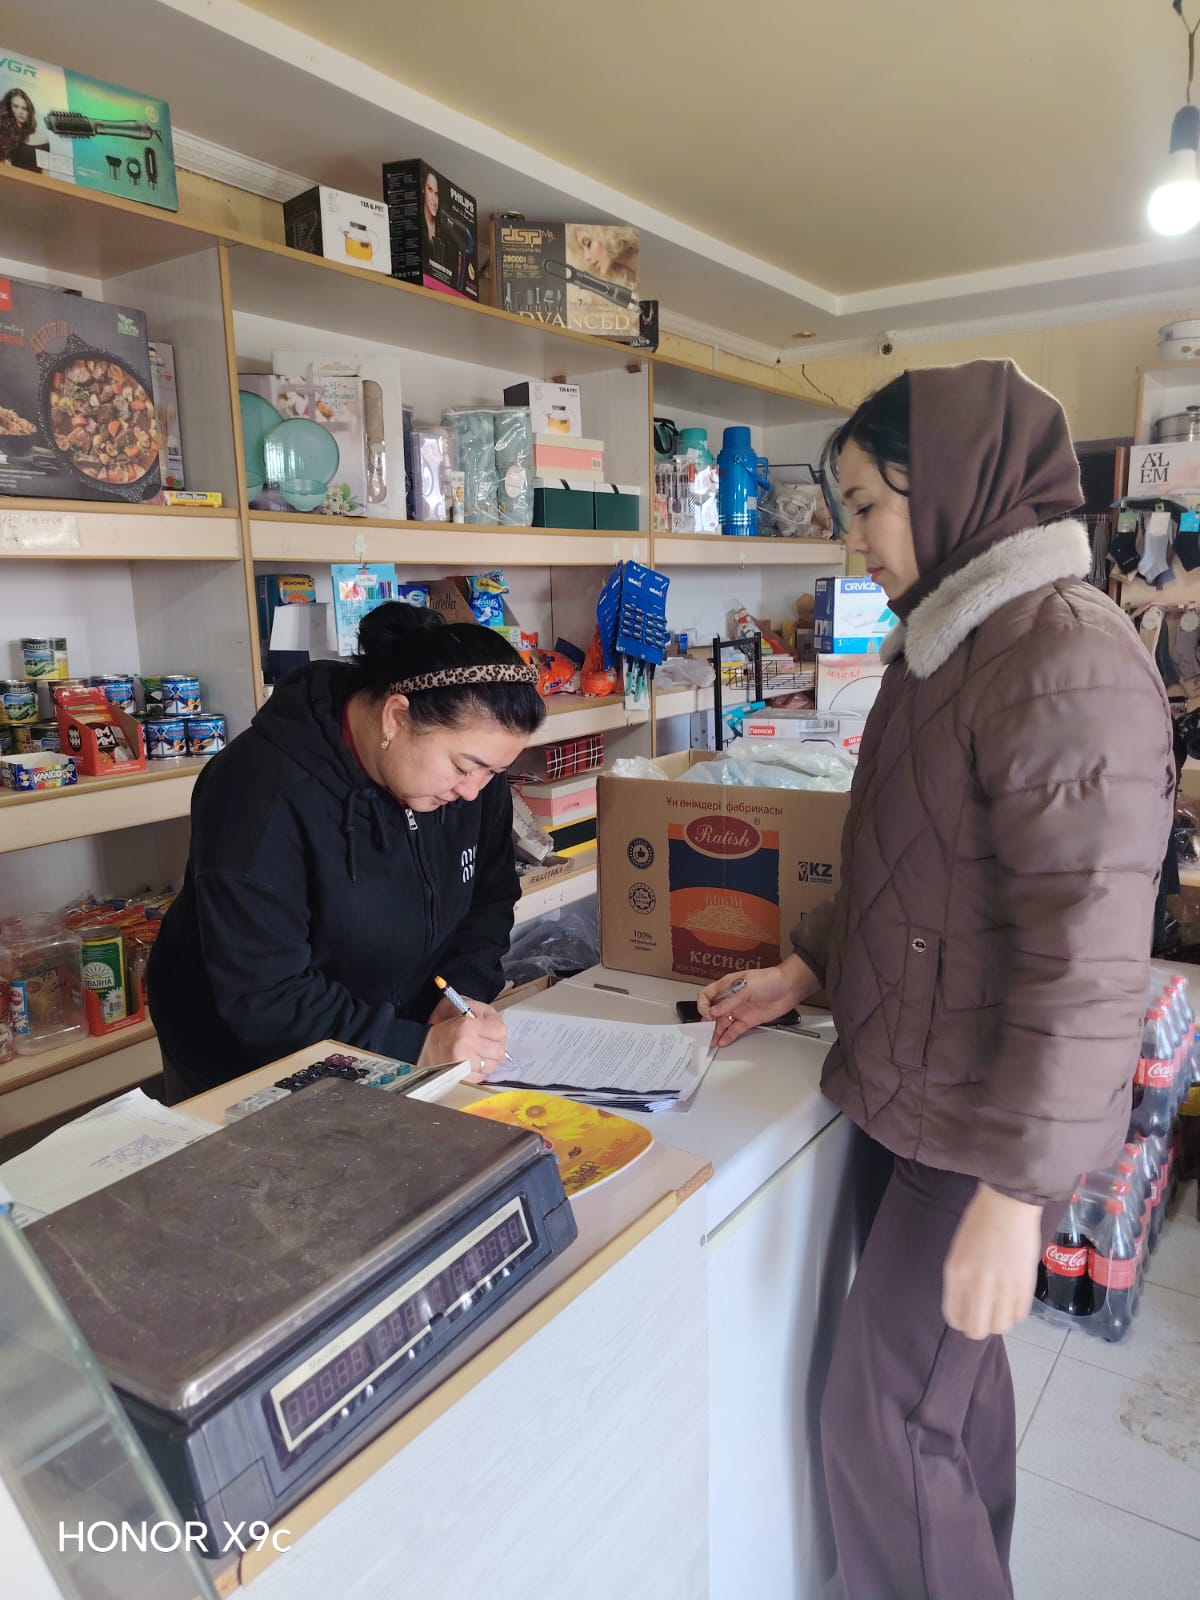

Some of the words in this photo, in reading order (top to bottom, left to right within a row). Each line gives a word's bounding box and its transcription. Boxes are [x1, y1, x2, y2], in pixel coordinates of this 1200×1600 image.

[1140, 467, 1168, 483] EM
[33, 769, 63, 784] KANGO
[680, 799, 722, 812] өнімдері
[726, 801, 784, 815] фабрикасы
[690, 949, 762, 971] кеспесі
